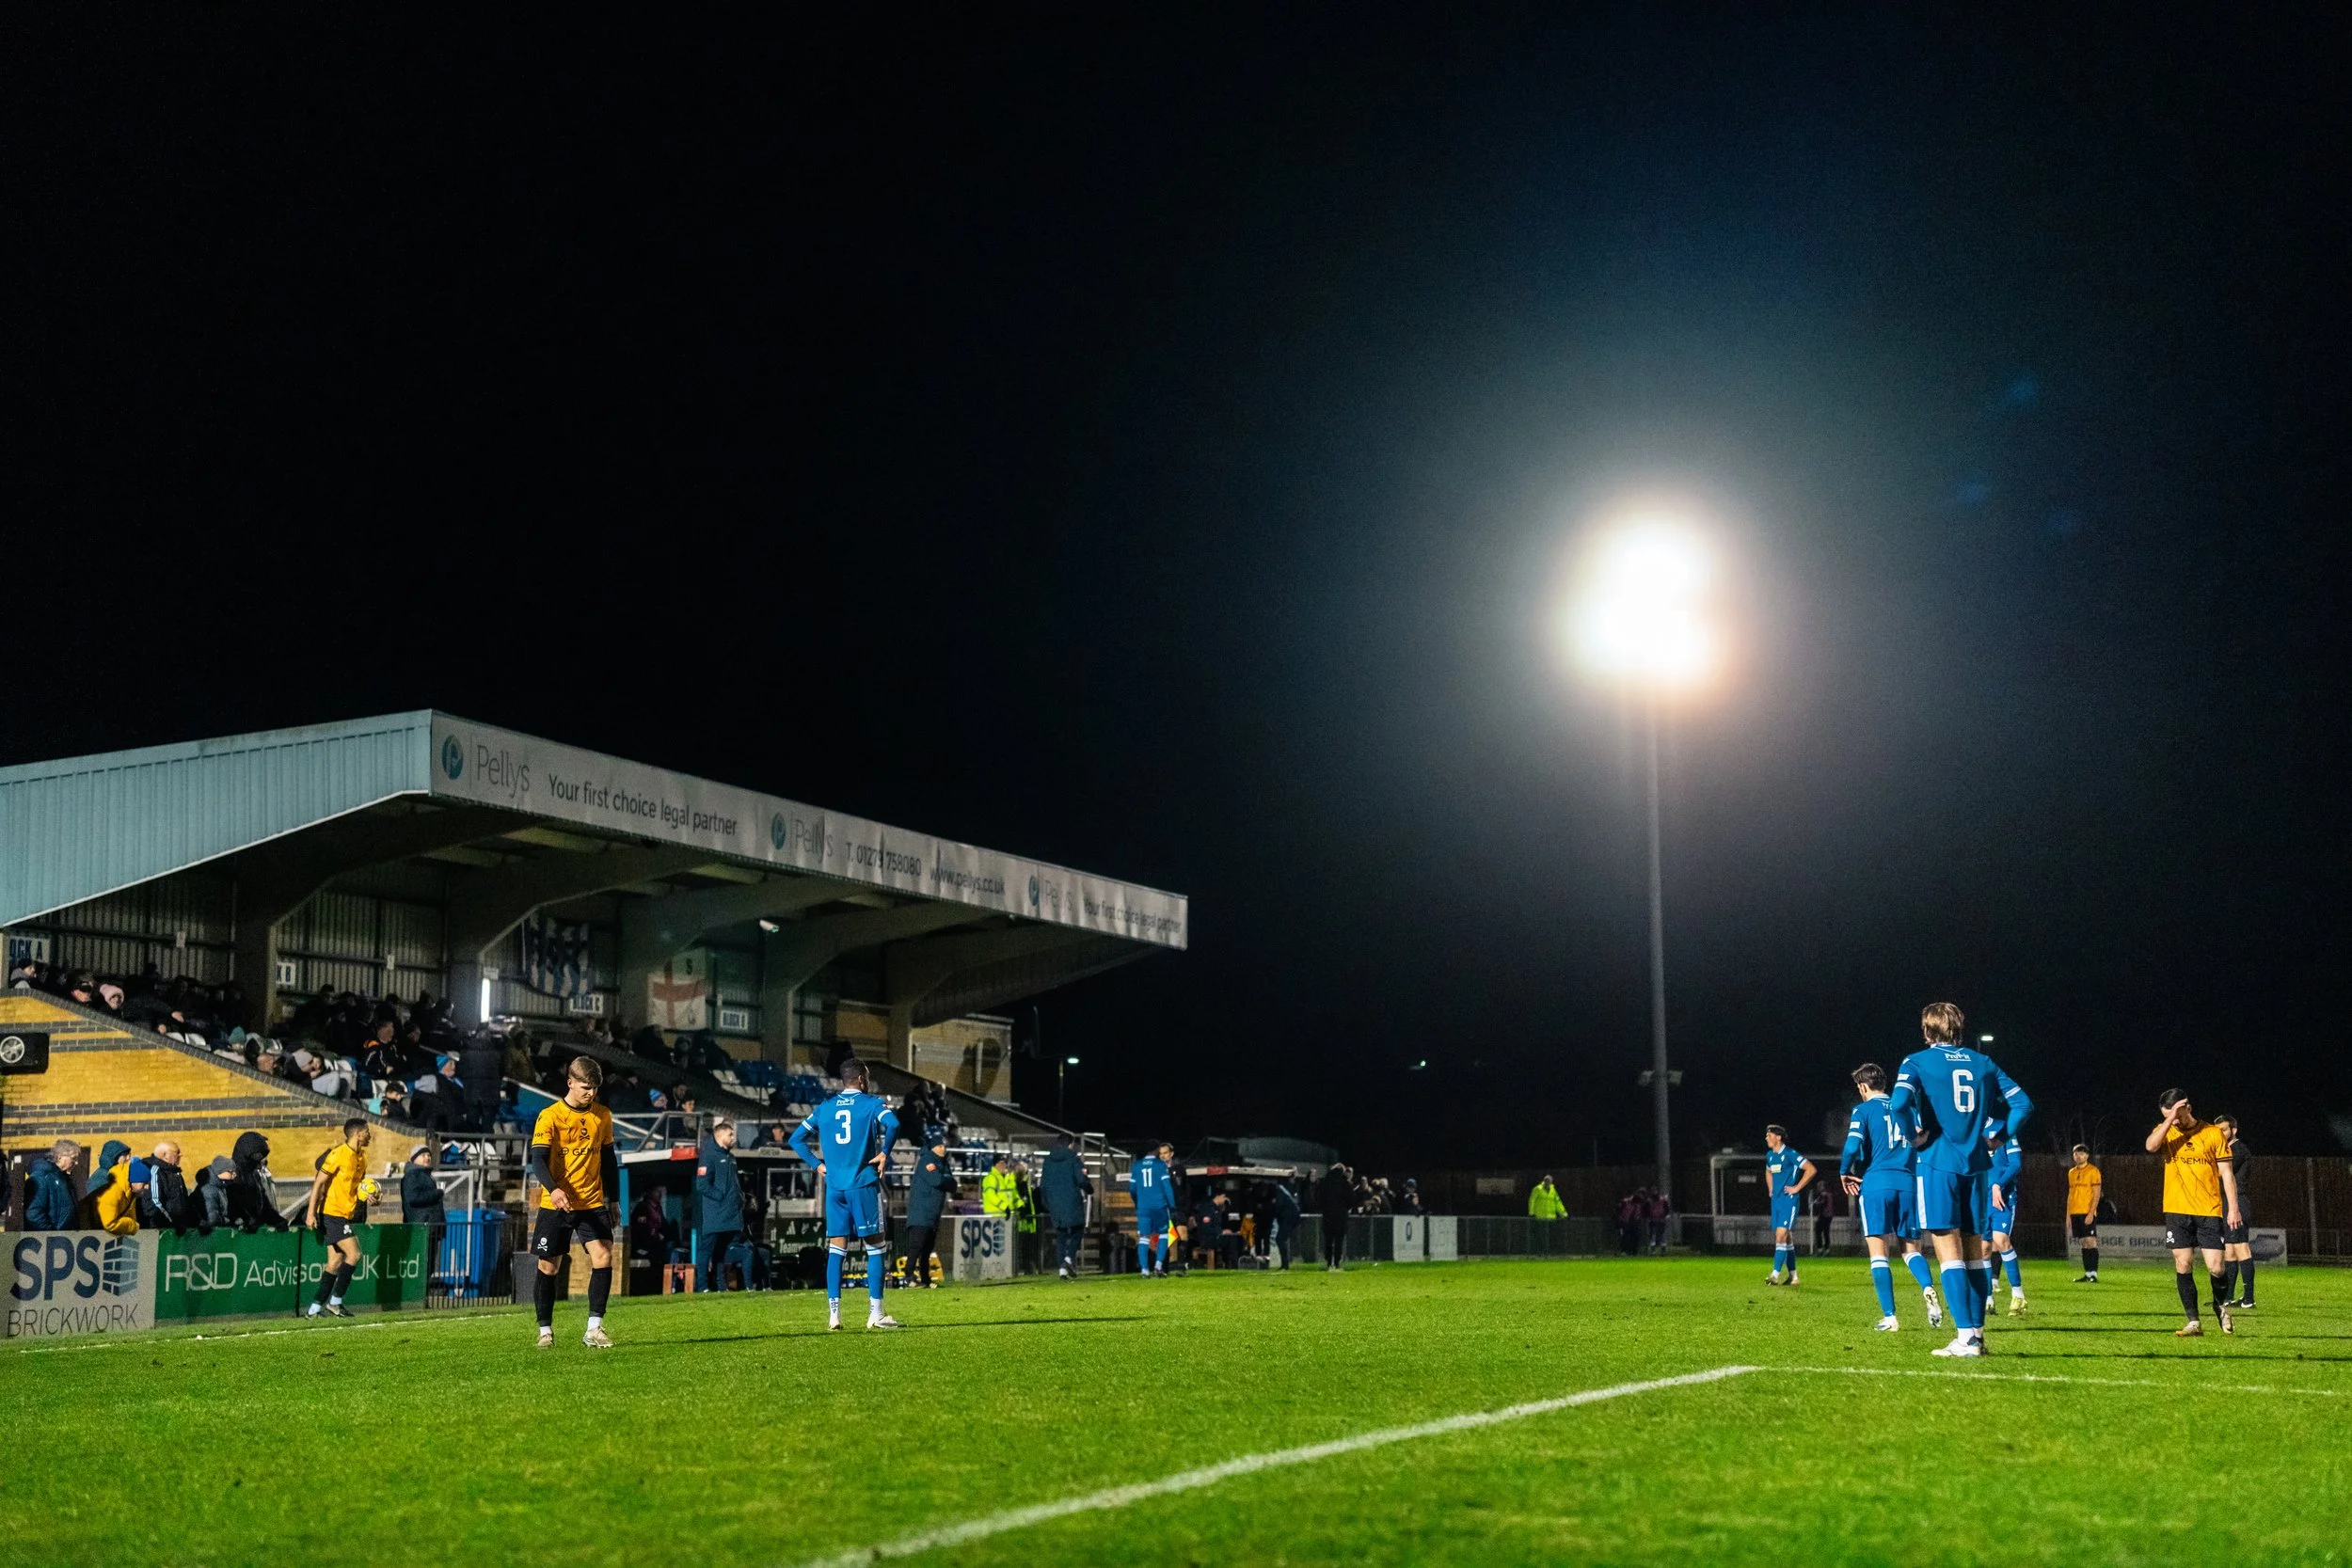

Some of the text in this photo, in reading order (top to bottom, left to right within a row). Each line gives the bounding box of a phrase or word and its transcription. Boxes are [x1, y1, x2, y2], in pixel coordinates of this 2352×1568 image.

[476, 745, 738, 836] Pellys Your first choice legal partner
[885, 850, 922, 877] 758080
[1952, 1069, 1976, 1113] 6
[834, 1109, 851, 1145] 3
[1883, 1113, 1907, 1149] 14
[1141, 1166, 1152, 1187] 11
[961, 1219, 993, 1259] SPS
[9, 1234, 102, 1302] SPS
[166, 1252, 238, 1293] R&D
[386, 1252, 420, 1279] Ltd
[7, 1304, 138, 1338] BRICKWORK
